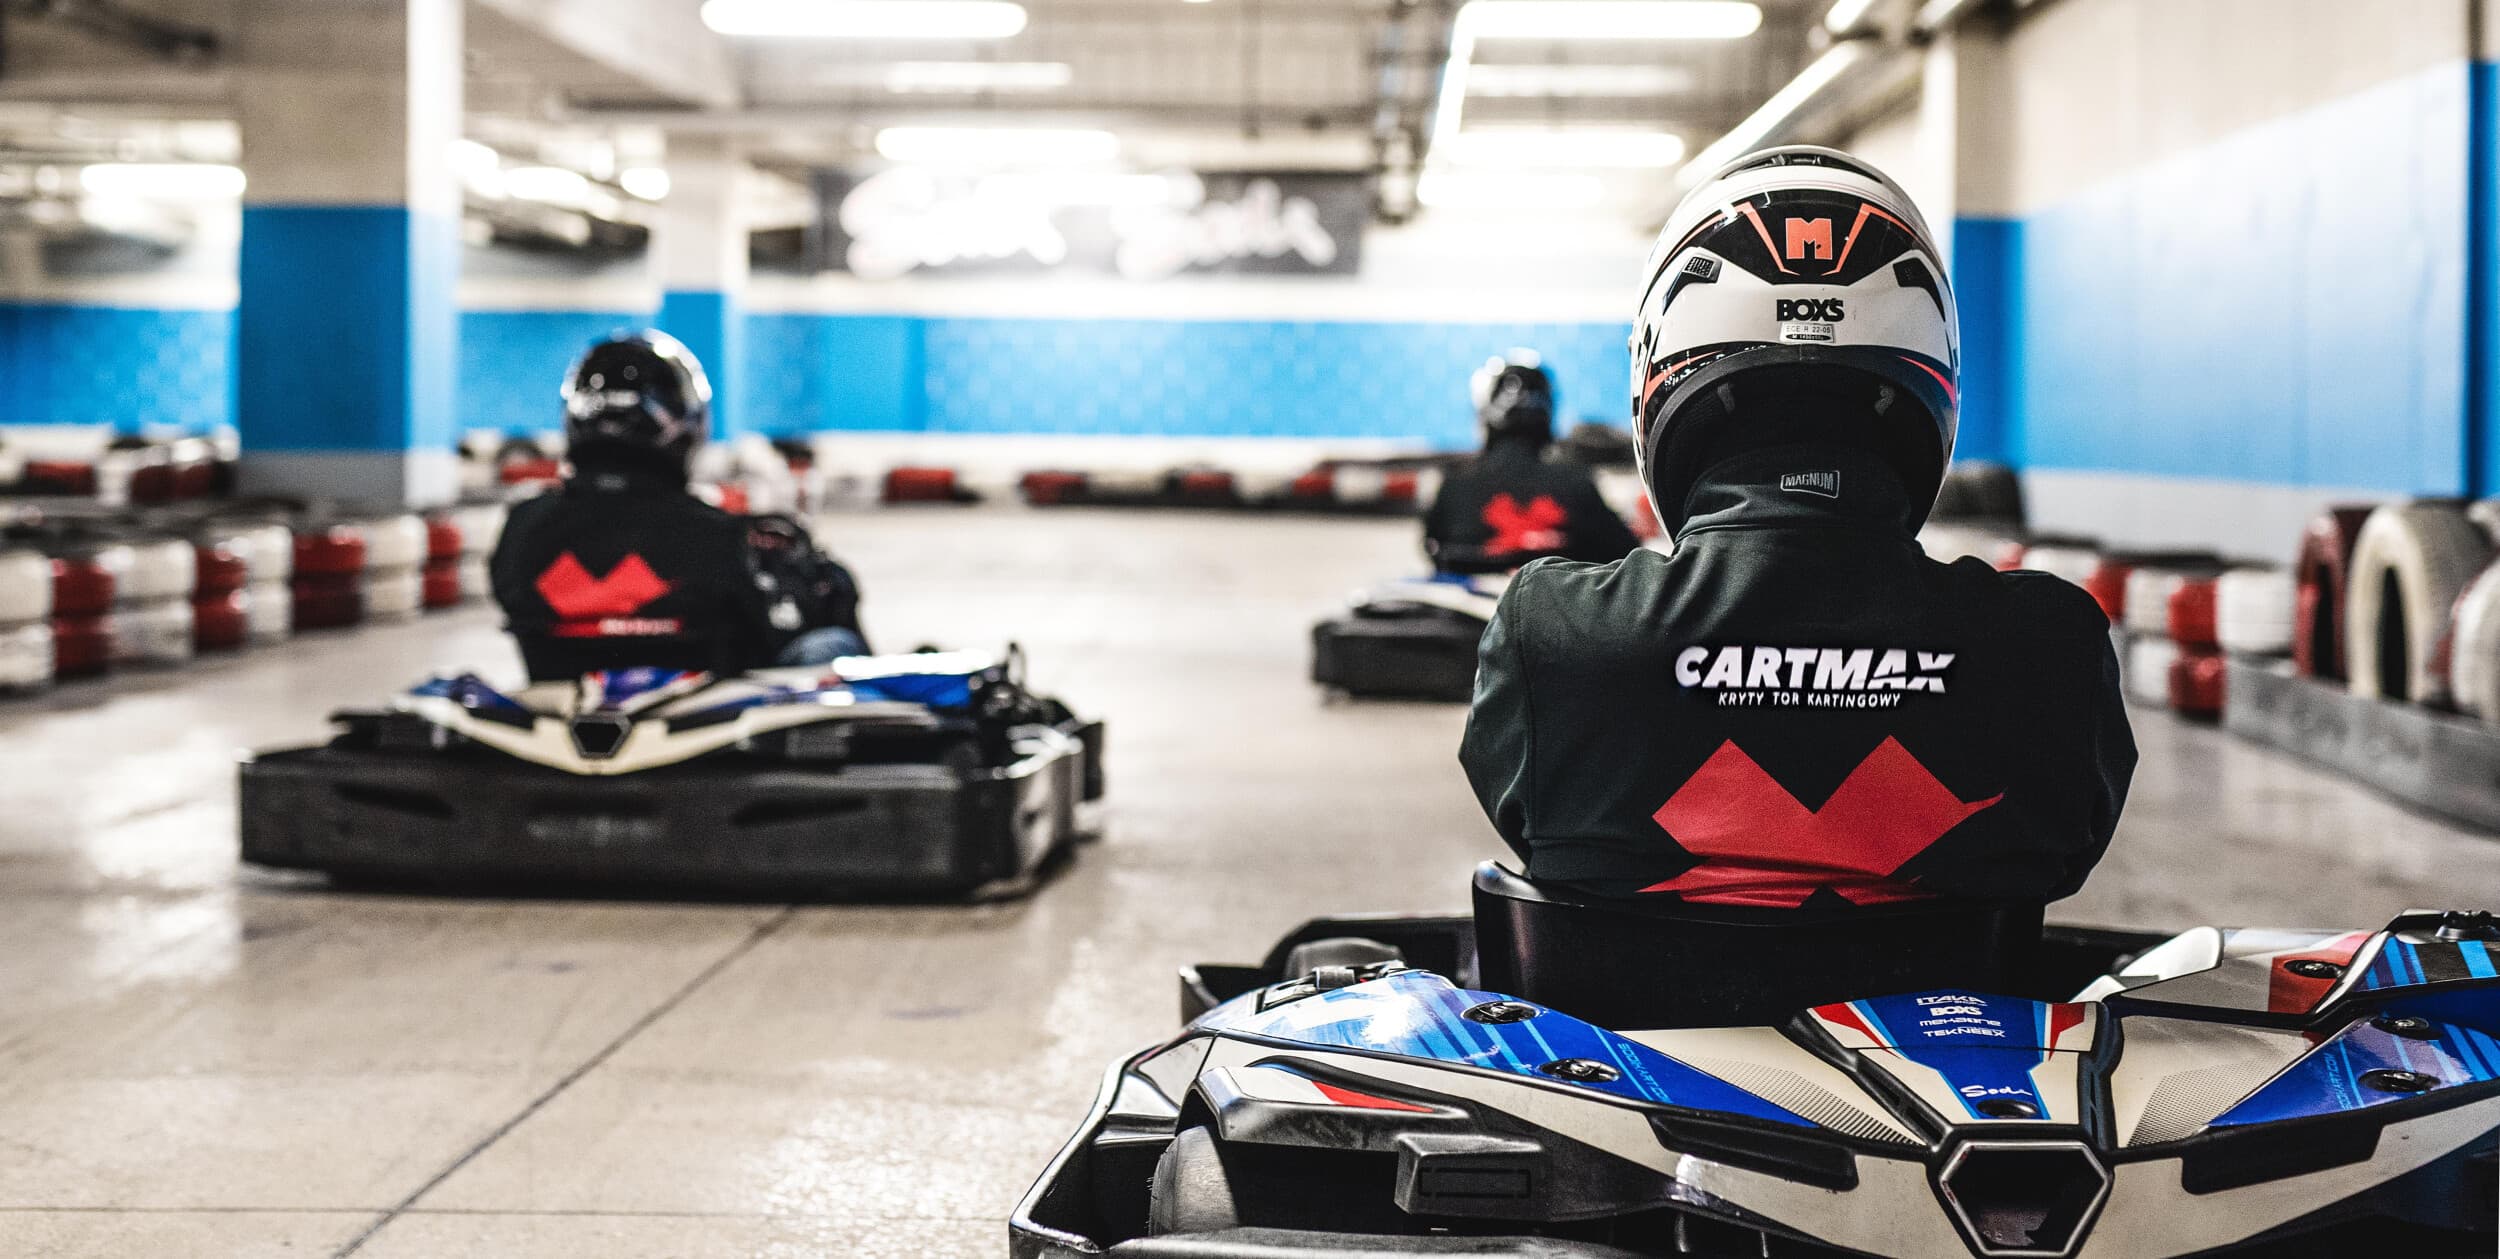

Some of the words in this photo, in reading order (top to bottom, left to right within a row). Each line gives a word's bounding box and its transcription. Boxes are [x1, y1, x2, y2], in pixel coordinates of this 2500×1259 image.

[1785, 217, 1832, 260] M
[1785, 472, 1834, 491] MAGNUM
[1675, 646, 1956, 694] CARTMAX
[1718, 692, 1764, 706] KRYTY
[1772, 692, 1799, 706] TOR
[1807, 693, 1900, 708] KARTINGOWY
